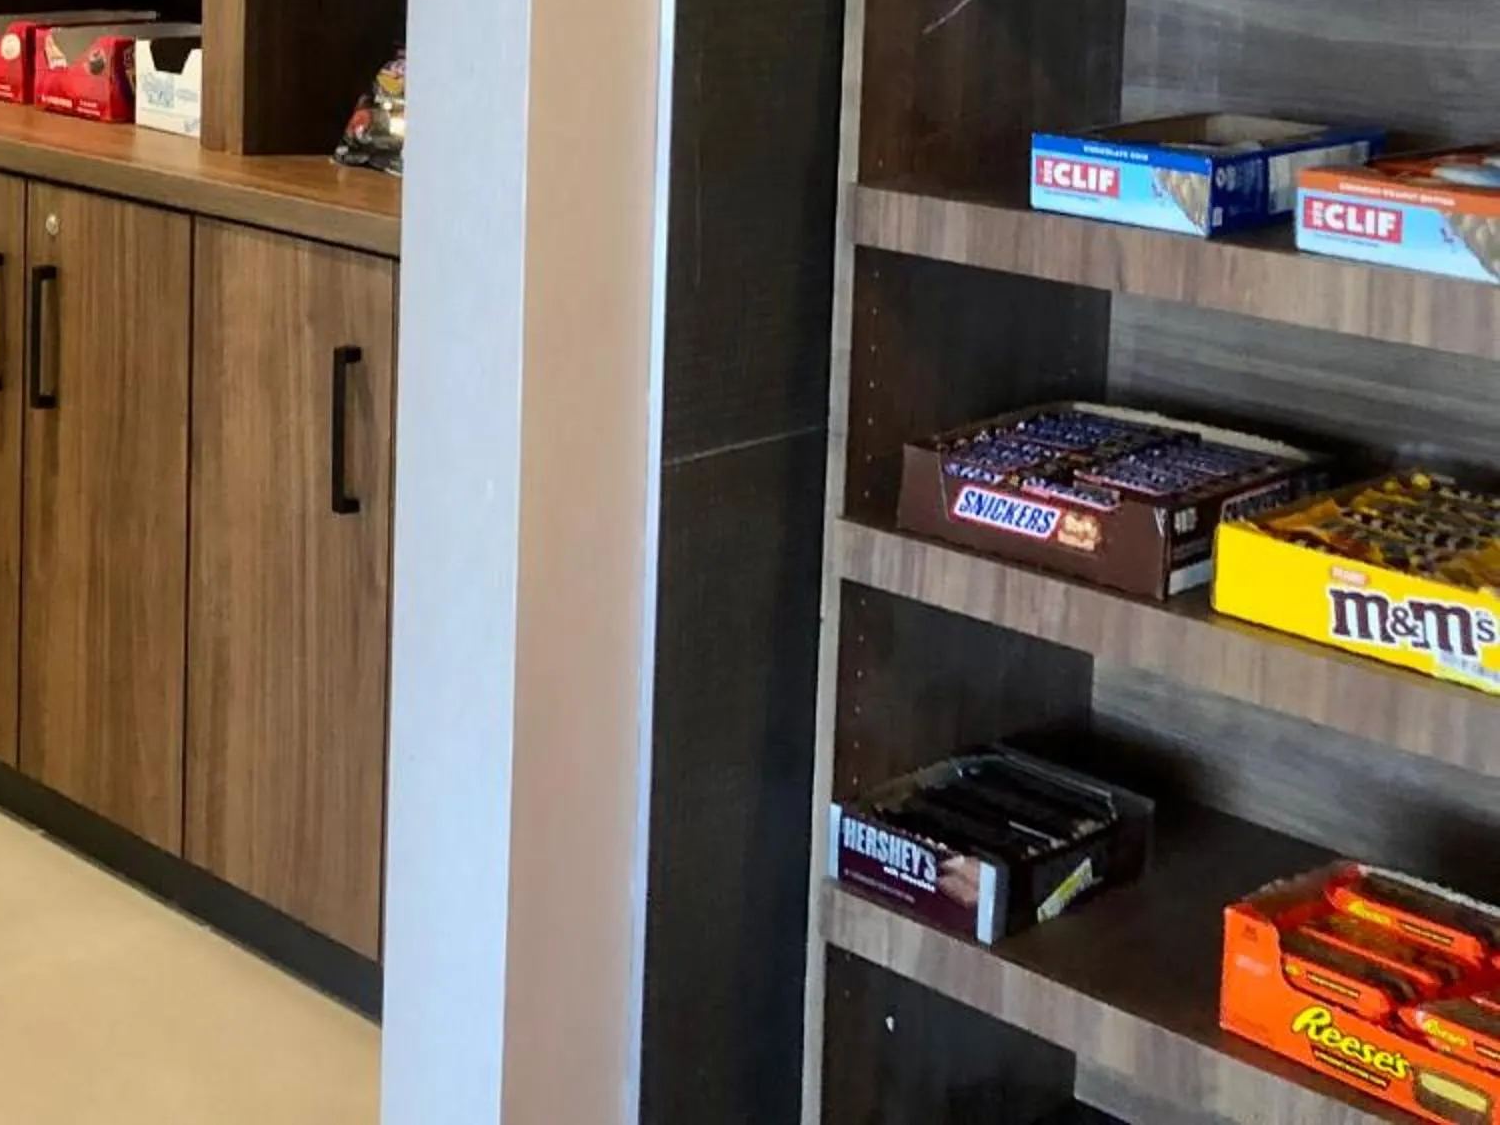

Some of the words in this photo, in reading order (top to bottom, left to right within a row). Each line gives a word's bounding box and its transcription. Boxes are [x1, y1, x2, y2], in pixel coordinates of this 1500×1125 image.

[1053, 162, 1115, 193] CLIF
[1324, 206, 1397, 238] CLIF
[958, 490, 1056, 534] SNICKERS
[842, 817, 937, 884] HERSHEY'S
[1292, 1006, 1410, 1079] Reese's
